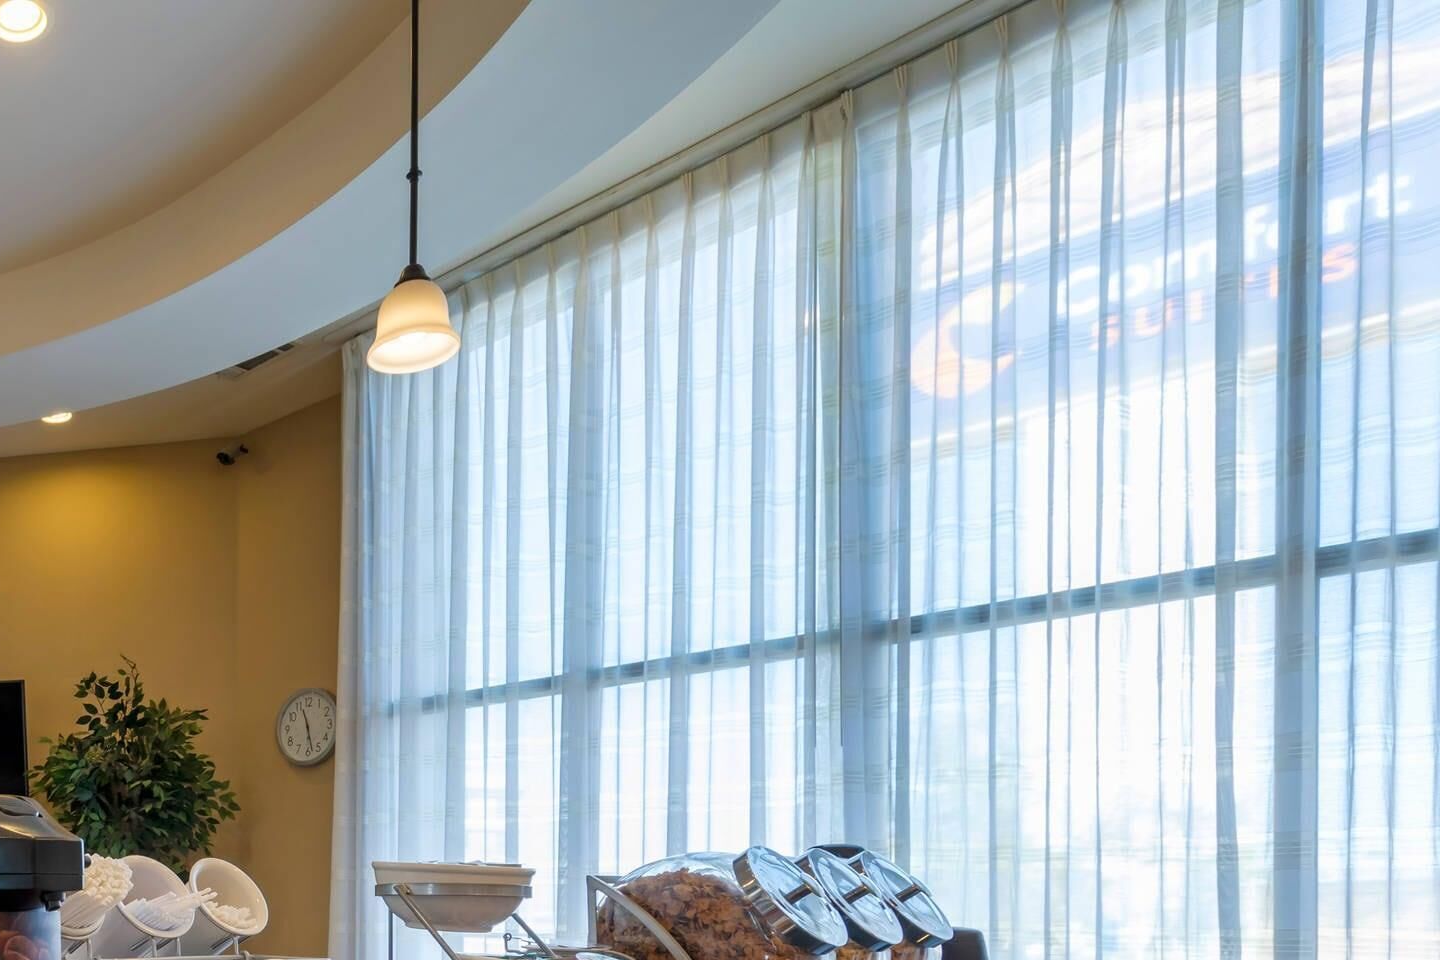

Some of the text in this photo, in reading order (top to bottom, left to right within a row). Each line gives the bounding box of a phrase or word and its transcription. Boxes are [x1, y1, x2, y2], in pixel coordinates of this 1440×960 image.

[296, 702, 302, 712] 11
[305, 697, 313, 707] 12
[289, 711, 297, 722] 10
[324, 706, 330, 717] 2
[327, 719, 332, 729] 3
[285, 725, 290, 734] 9
[287, 736, 293, 746] 8
[323, 732, 328, 742] 4
[296, 744, 301, 754] 7
[305, 747, 311, 757] 6
[315, 742, 321, 752] 5
